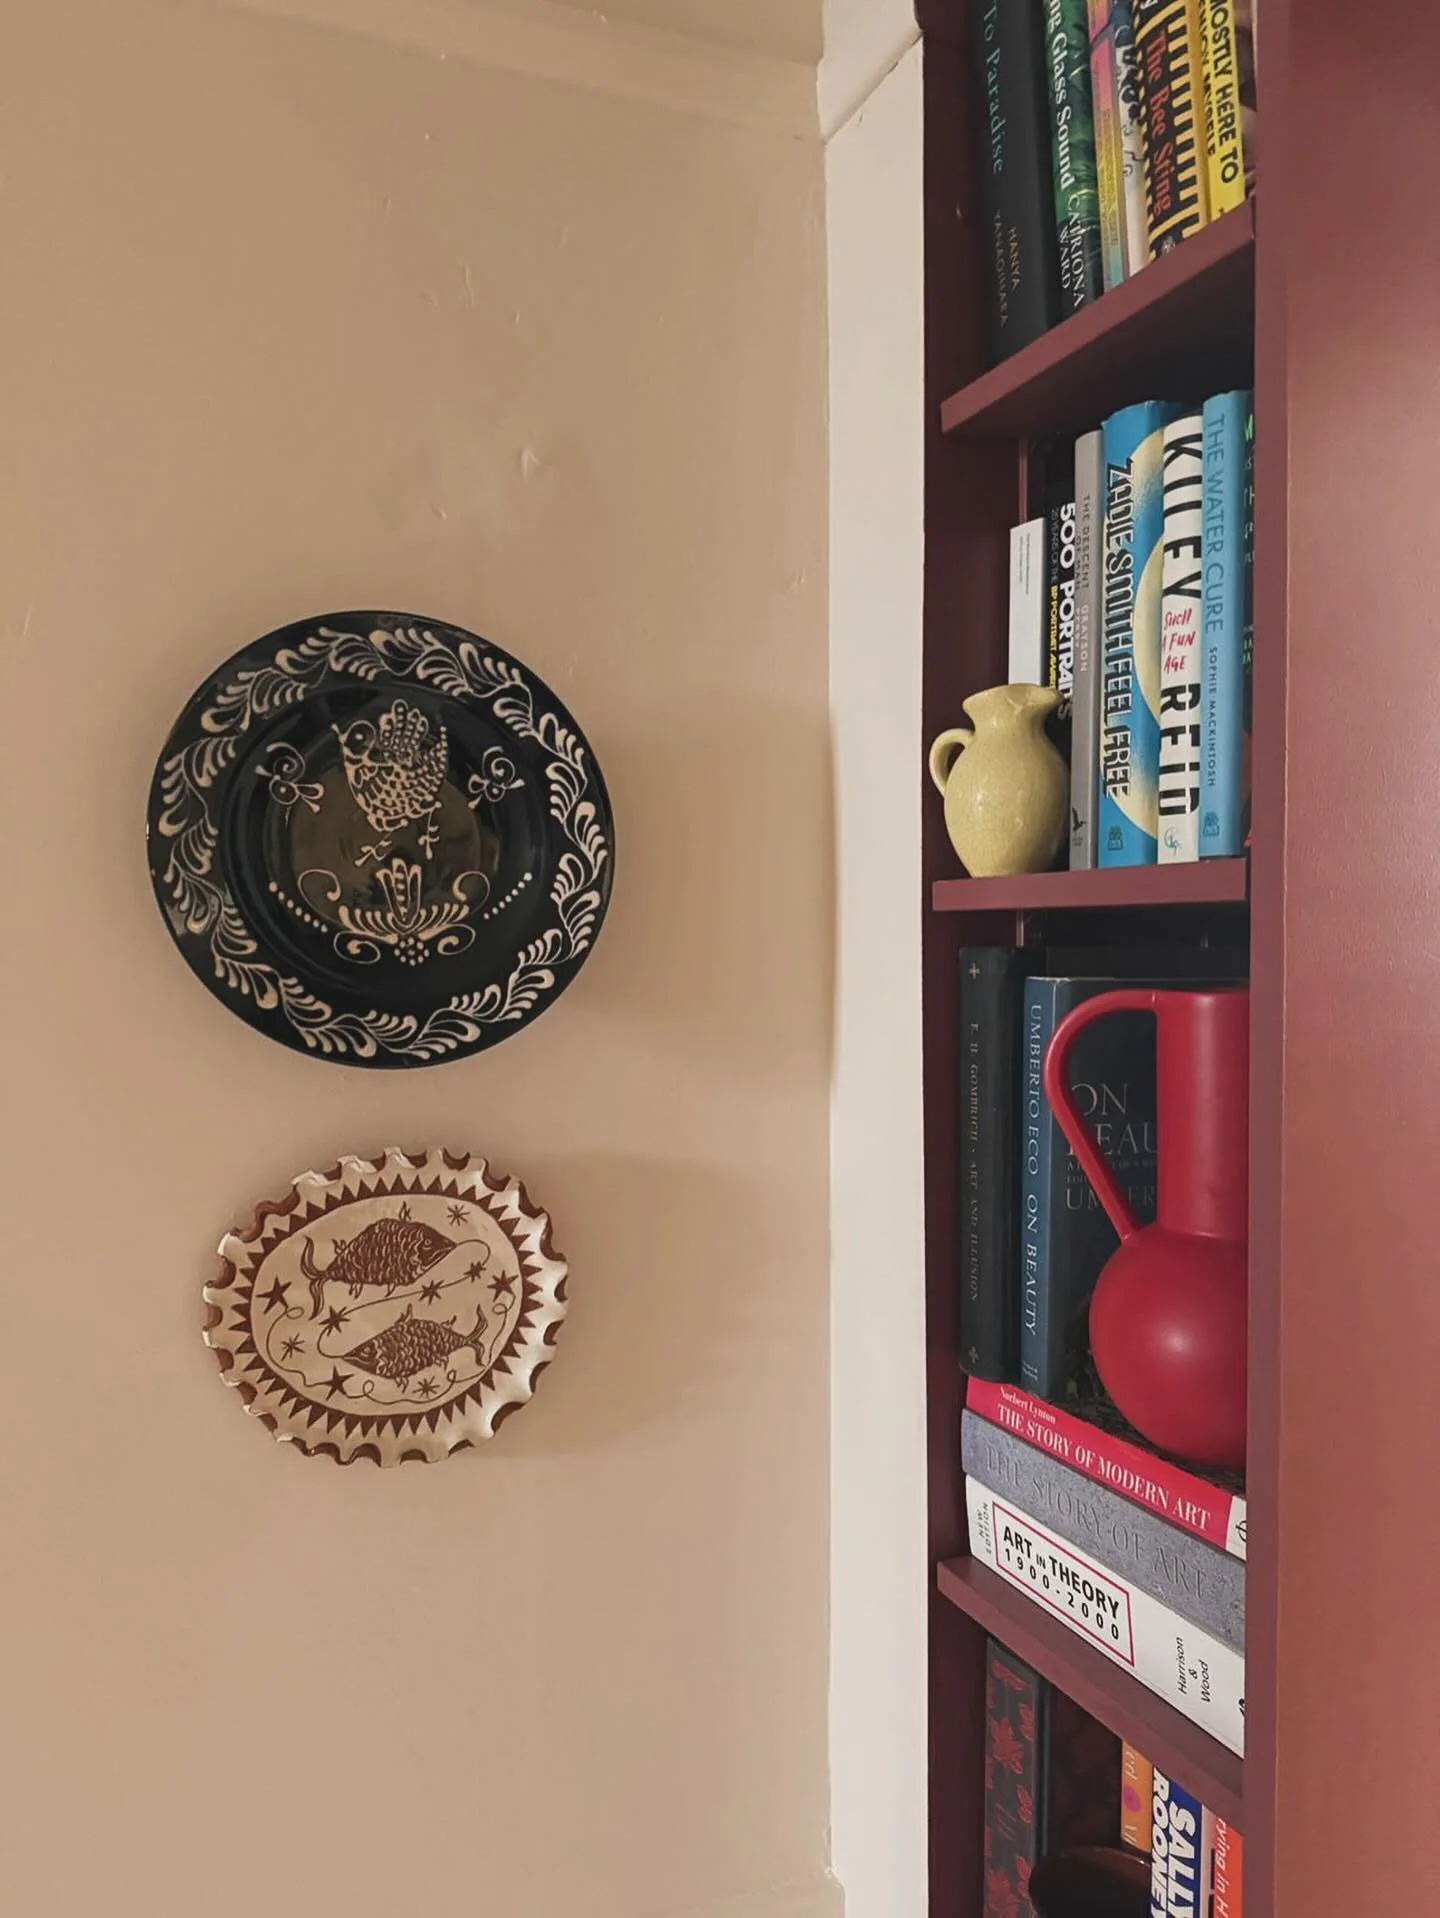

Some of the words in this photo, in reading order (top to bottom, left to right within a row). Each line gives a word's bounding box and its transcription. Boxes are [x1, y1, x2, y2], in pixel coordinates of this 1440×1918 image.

[1052, 32, 1068, 104] Glass
[986, 48, 1006, 175] Paradise
[1151, 84, 1170, 138] Bee
[1215, 83, 1237, 146] HERE
[1056, 105, 1075, 191] Sound
[1220, 147, 1238, 183] TO
[1059, 225, 1072, 289] WARD
[1067, 194, 1085, 307] CATRIONA
[1206, 413, 1225, 464] THE
[1060, 502, 1075, 568] 500
[1107, 457, 1133, 549] ZADIE
[1206, 470, 1224, 554] WATER
[1106, 550, 1133, 651] SMITH
[1205, 563, 1223, 633] CURE
[1105, 652, 1132, 722] FEEL
[1164, 654, 1187, 674] AGE
[1208, 647, 1217, 693] SOPHIE
[1104, 726, 1131, 799] FREE
[1208, 700, 1217, 786] MACKINTOSH
[1029, 1004, 1041, 1118] UMBERTO
[1028, 1126, 1040, 1175] ECO
[1027, 1194, 1038, 1232] ON
[1025, 1243, 1038, 1336] BEAUTY
[1000, 1385, 1028, 1411] Norbert
[998, 1403, 1024, 1433] THE
[1026, 1420, 1073, 1457] STORY
[1075, 1446, 1096, 1468] OF
[1098, 1455, 1169, 1510] MODERN
[1173, 1497, 1211, 1530] ART
[1003, 1525, 1033, 1559] ART
[1036, 1553, 1046, 1570] IN
[1049, 1555, 1119, 1620] THEORY
[1032, 1479, 1099, 1536] STORY
[1112, 1522, 1144, 1561] OF
[1153, 1546, 1206, 1599] ART
[1176, 1636, 1187, 1695] Harrison
[1188, 1668, 1198, 1680] &
[1198, 1659, 1211, 1703] Wood
[1215, 1817, 1231, 1871] rying
[1216, 1877, 1230, 1894] in
